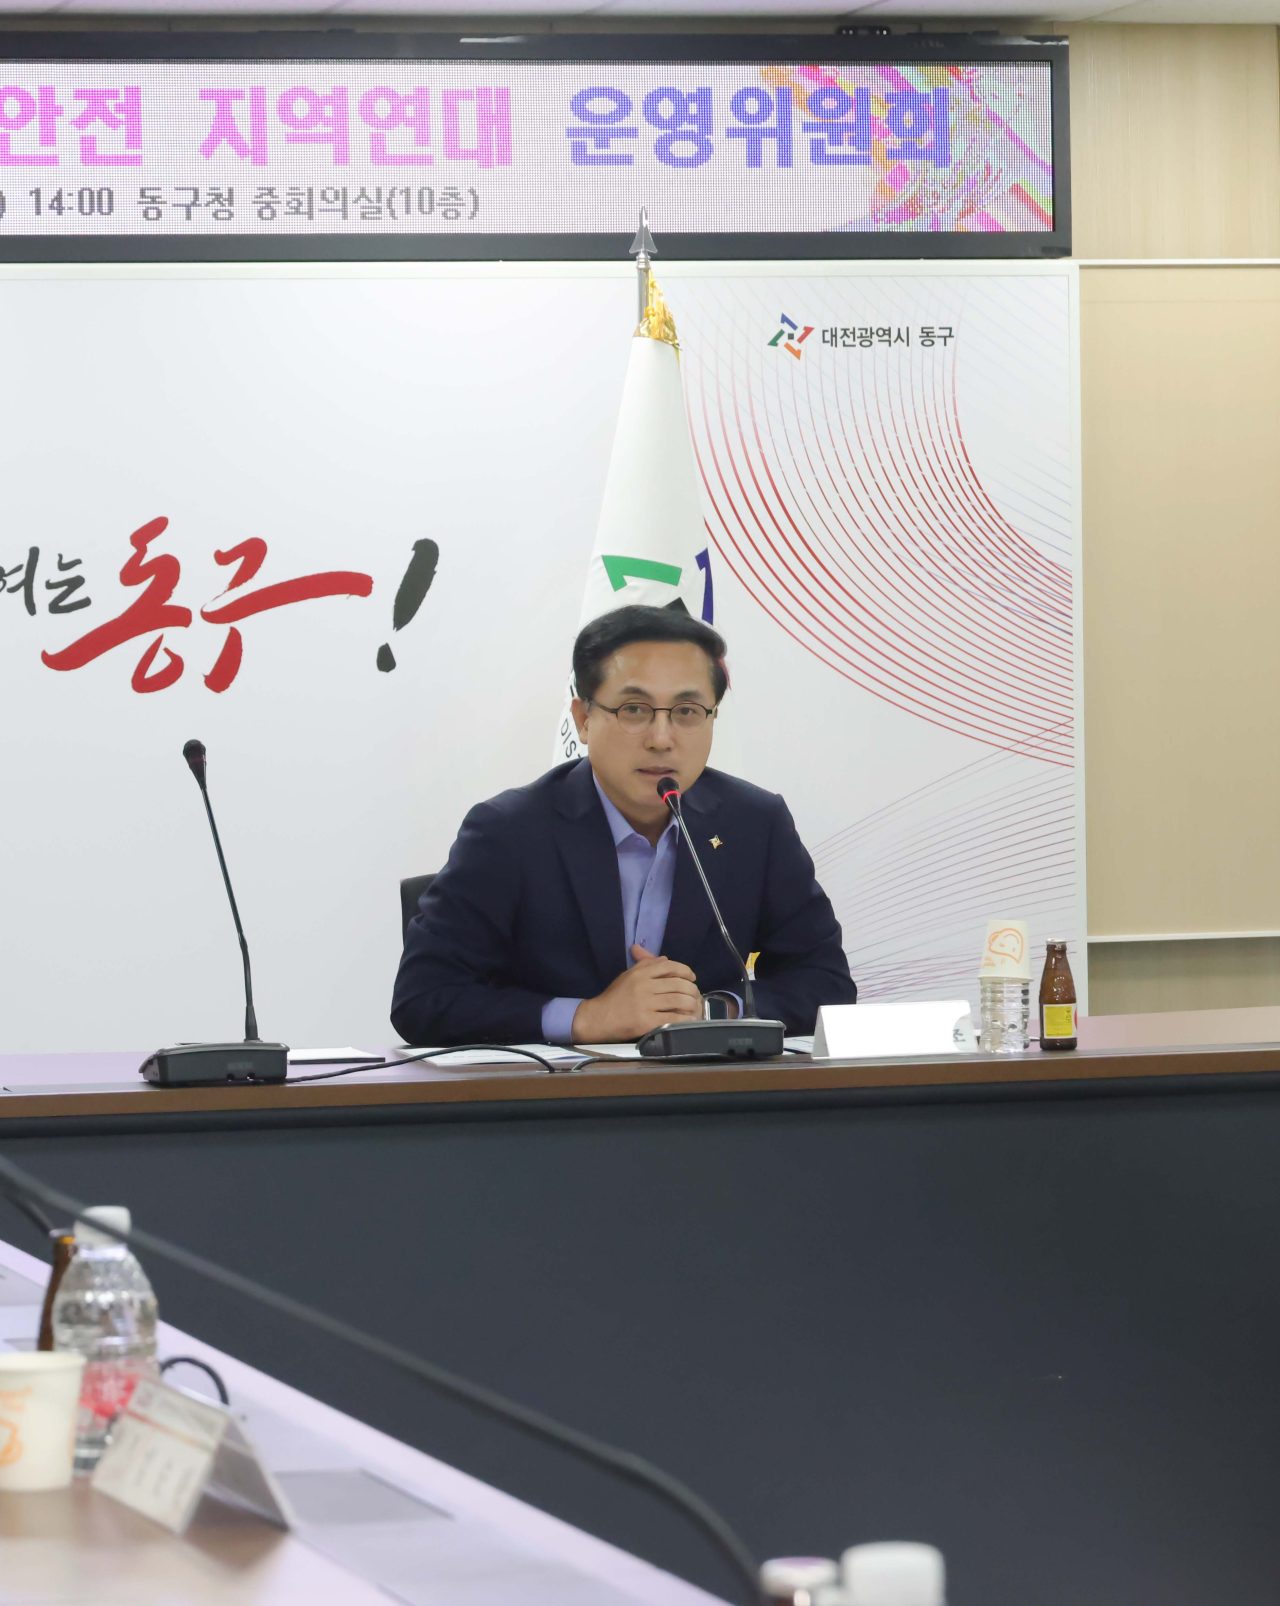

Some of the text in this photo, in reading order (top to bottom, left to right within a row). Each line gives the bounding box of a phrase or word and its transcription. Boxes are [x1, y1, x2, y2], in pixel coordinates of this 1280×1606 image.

[198, 85, 513, 169] 지역연대
[566, 85, 951, 168] 운영위원회
[28, 187, 115, 217] 14:00
[136, 186, 235, 222] 동구청
[251, 186, 480, 221] 중회의실(10층)
[821, 326, 955, 348] 대전광역시 동구
